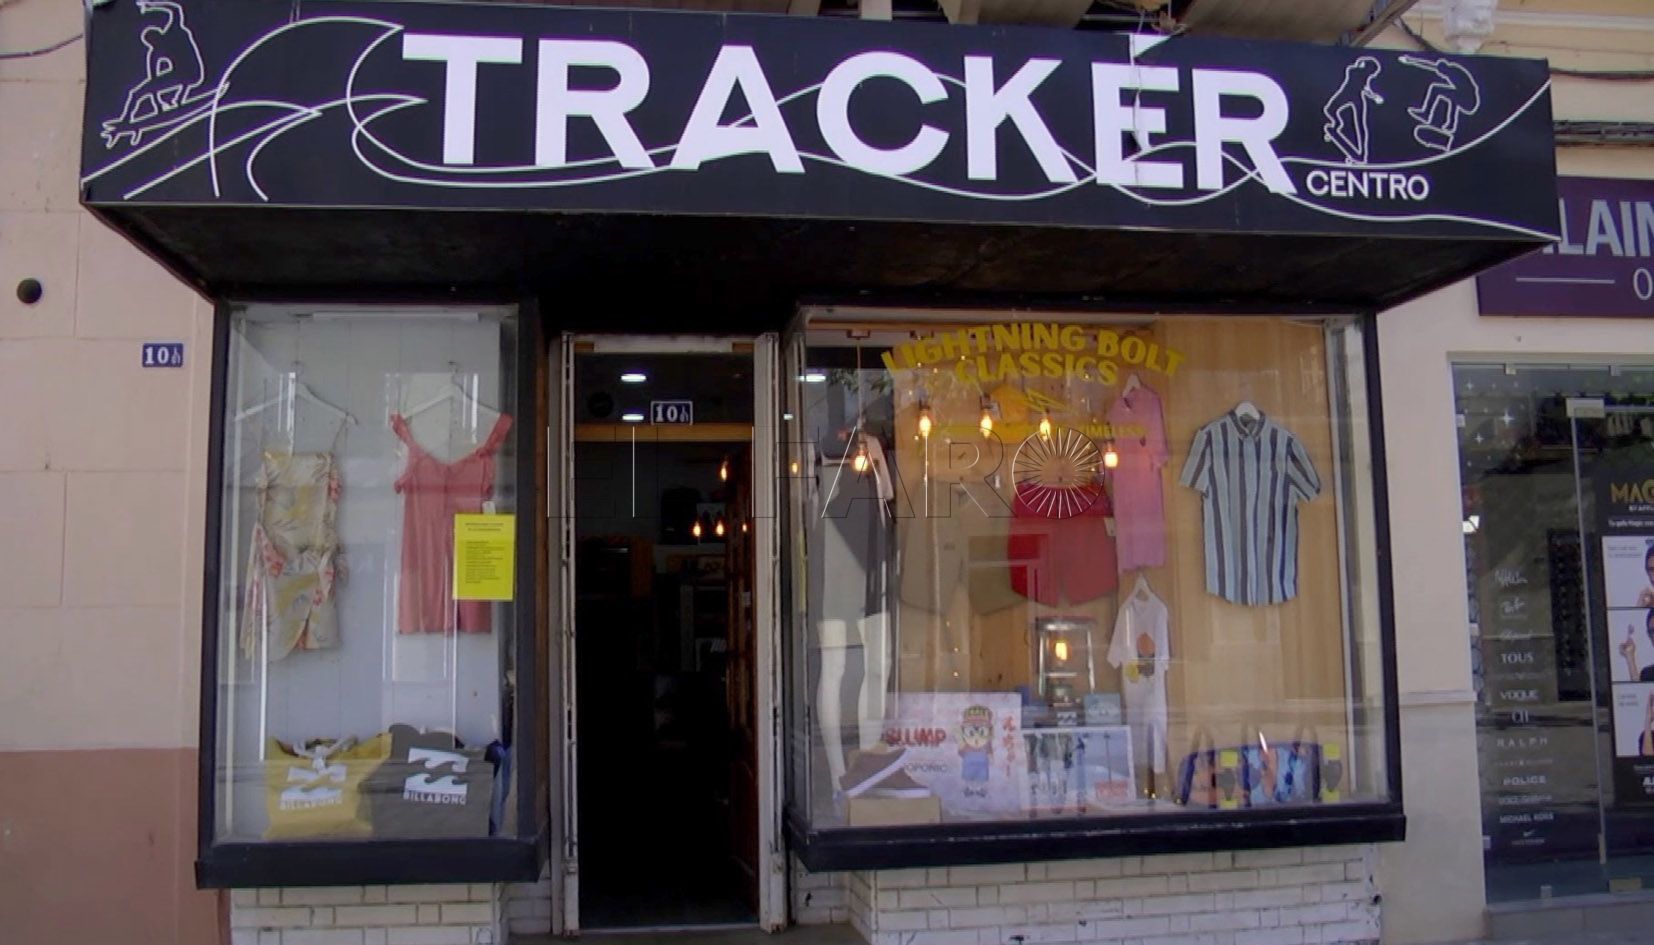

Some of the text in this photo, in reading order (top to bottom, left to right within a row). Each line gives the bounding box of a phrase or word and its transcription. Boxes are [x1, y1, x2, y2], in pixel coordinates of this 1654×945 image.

[403, 34, 1297, 194] TRACKER
[1306, 170, 1429, 200] CENTRO
[881, 322, 1186, 377] LIGHTNING BOLT
[955, 352, 1120, 385] CLASSICS
[1500, 653, 1534, 665] TOUS
[1500, 689, 1538, 701] VOGUE
[1497, 736, 1548, 748] RALPH
[1503, 775, 1547, 786] POLICE
[403, 792, 467, 806] BILLABONG
